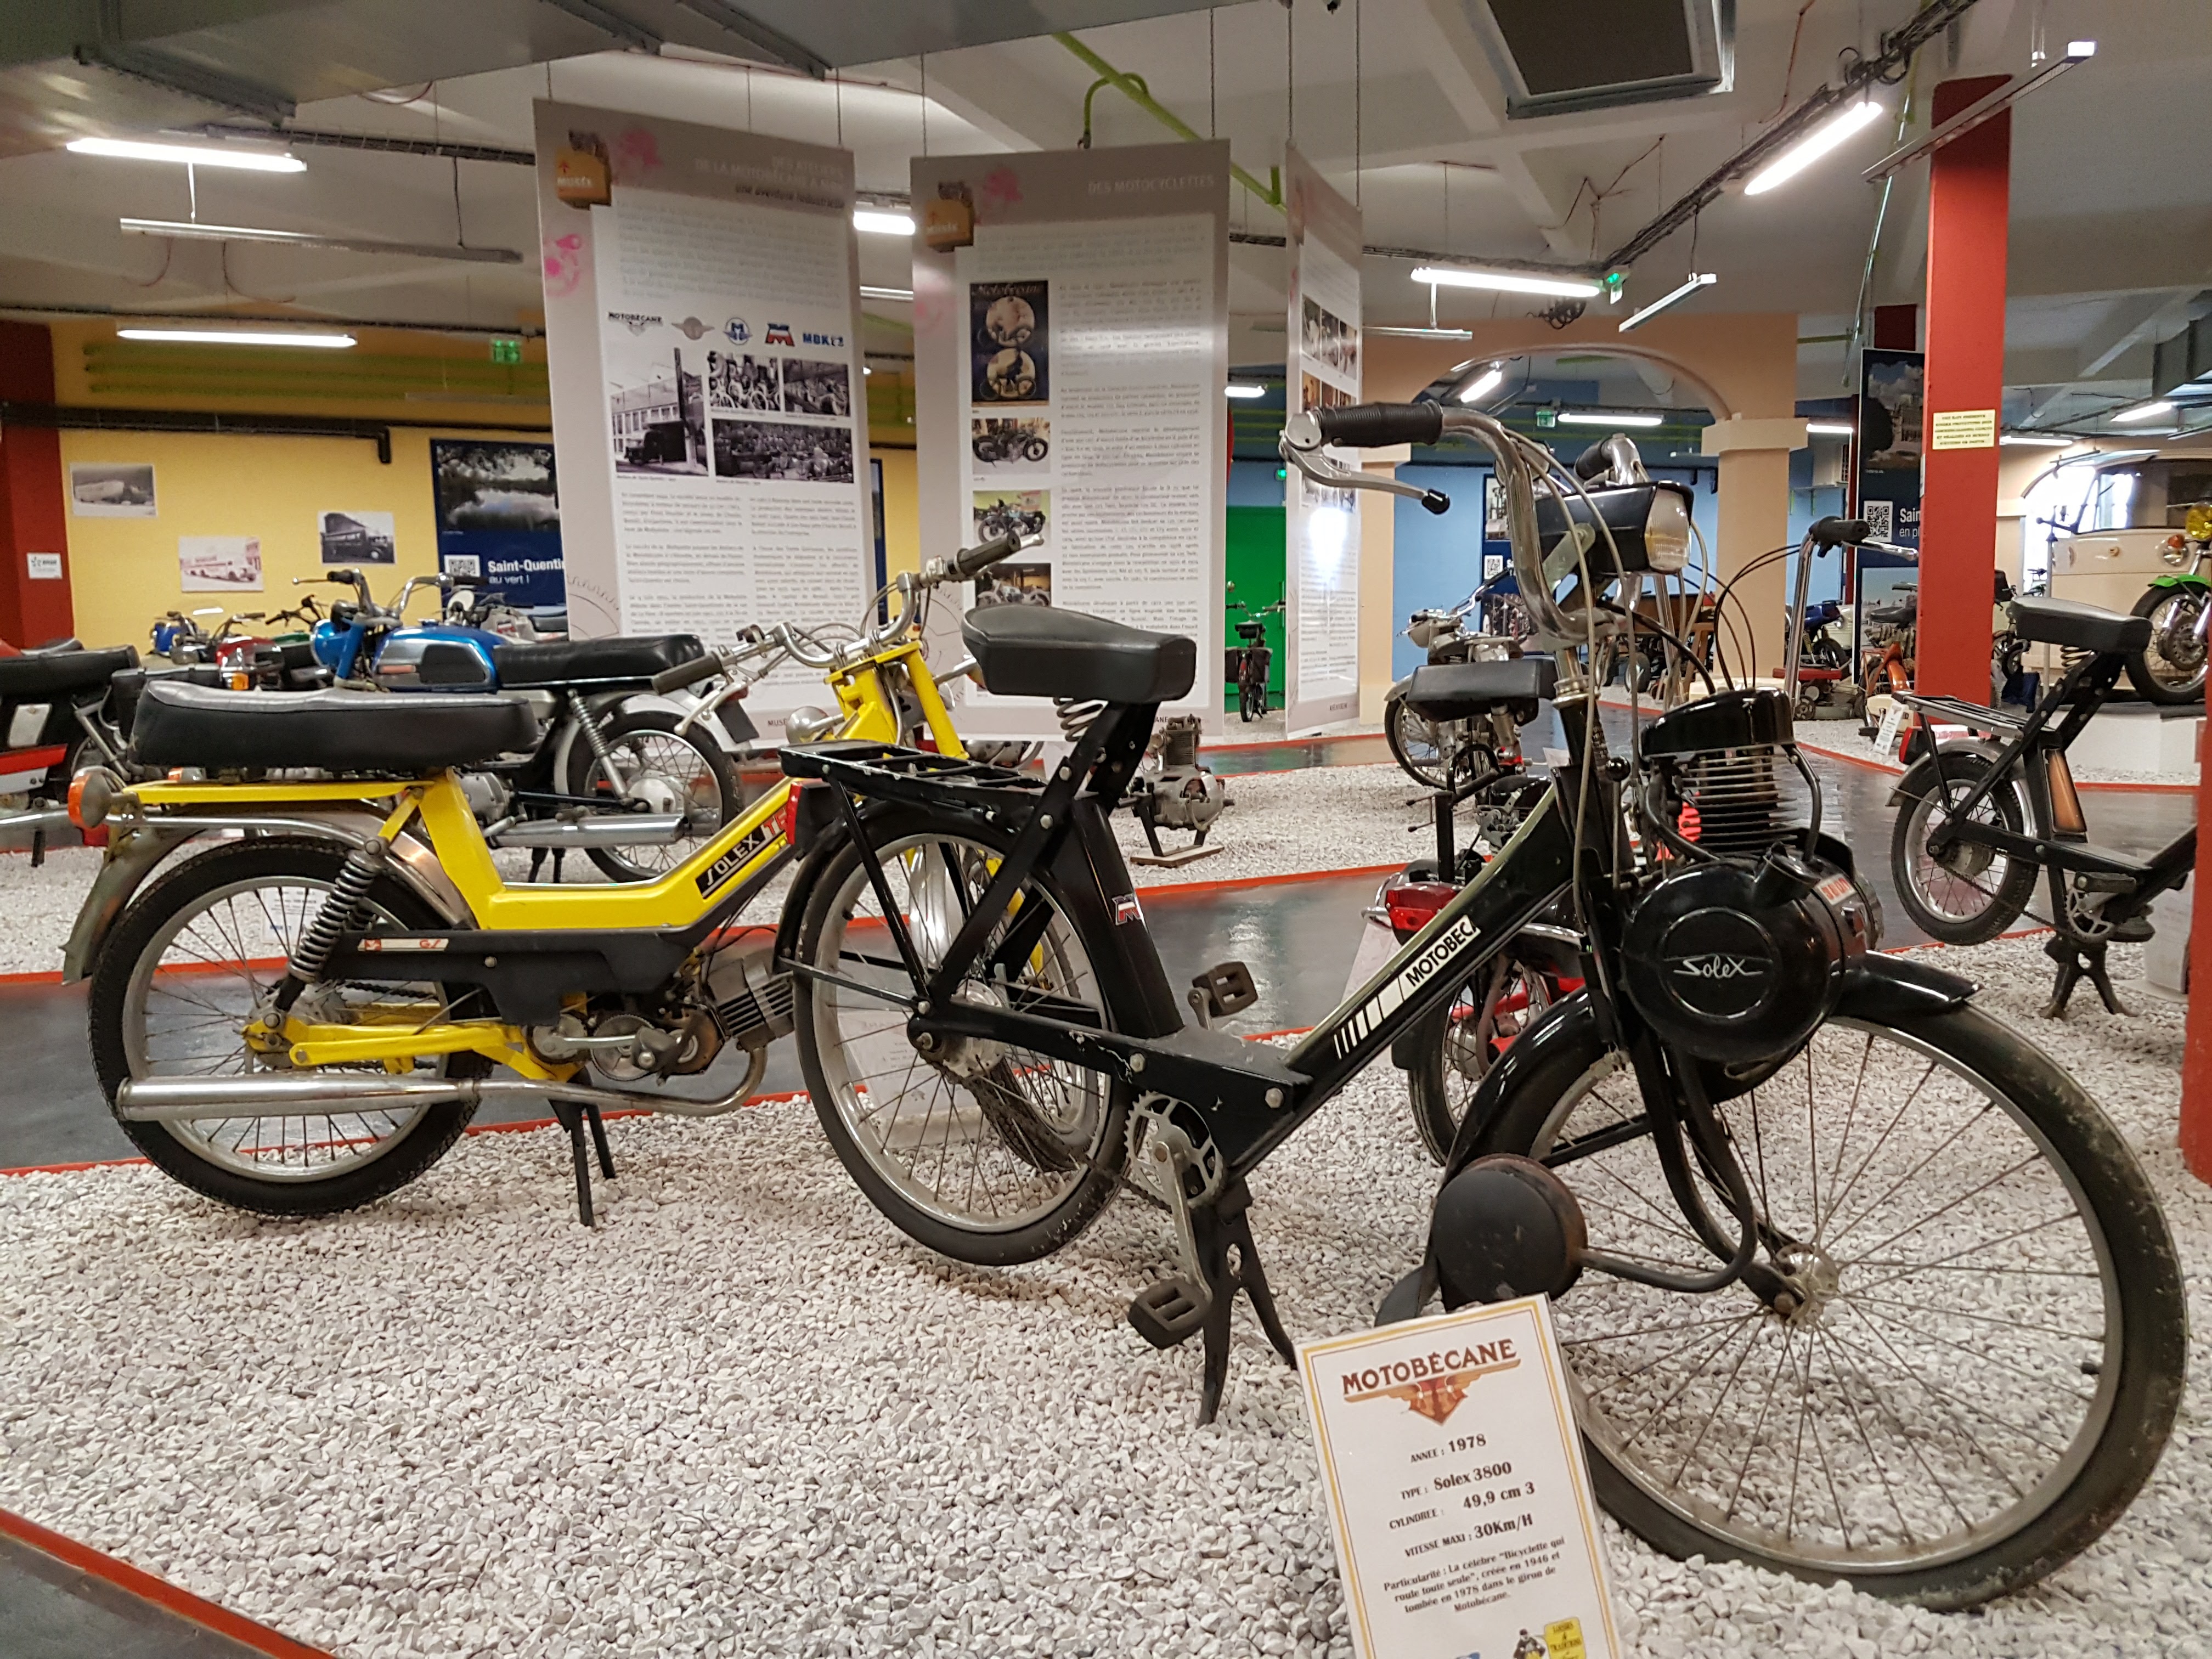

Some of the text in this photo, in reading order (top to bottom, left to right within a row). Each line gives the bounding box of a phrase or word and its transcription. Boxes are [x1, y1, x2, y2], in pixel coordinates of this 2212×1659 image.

[1899, 528, 1910, 537] en
[707, 834, 760, 886] SOLEX
[1341, 1338, 1517, 1395] MOTOBÉCANE
[1448, 1433, 1487, 1453] 1978
[1401, 1486, 1422, 1500] TYPE
[1434, 1472, 1472, 1491] Solex
[1473, 1461, 1512, 1481] 3800
[1463, 1491, 1496, 1509] 49,9
[1500, 1487, 1522, 1500] cm
[1525, 1481, 1536, 1494] 3
[1404, 1540, 1440, 1558] VITESSE
[1442, 1533, 1466, 1546] MAXI
[1474, 1513, 1533, 1539] 30Km/H
[1384, 1569, 1441, 1591] Particularité
[1448, 1564, 1460, 1573] La
[1551, 1536, 1565, 1548] qui
[1395, 1590, 1420, 1602] roule
[1422, 1582, 1445, 1595] toute
[1510, 1562, 1521, 1571] en
[1525, 1554, 1549, 1567] 1946
[1551, 1551, 1561, 1560] et
[1404, 1598, 1438, 1613] tombée
[1441, 1594, 1452, 1603] en
[1454, 1585, 1480, 1599] 1978
[1482, 1579, 1504, 1592] dans
[1506, 1576, 1515, 1584] le
[1545, 1566, 1556, 1576] de
